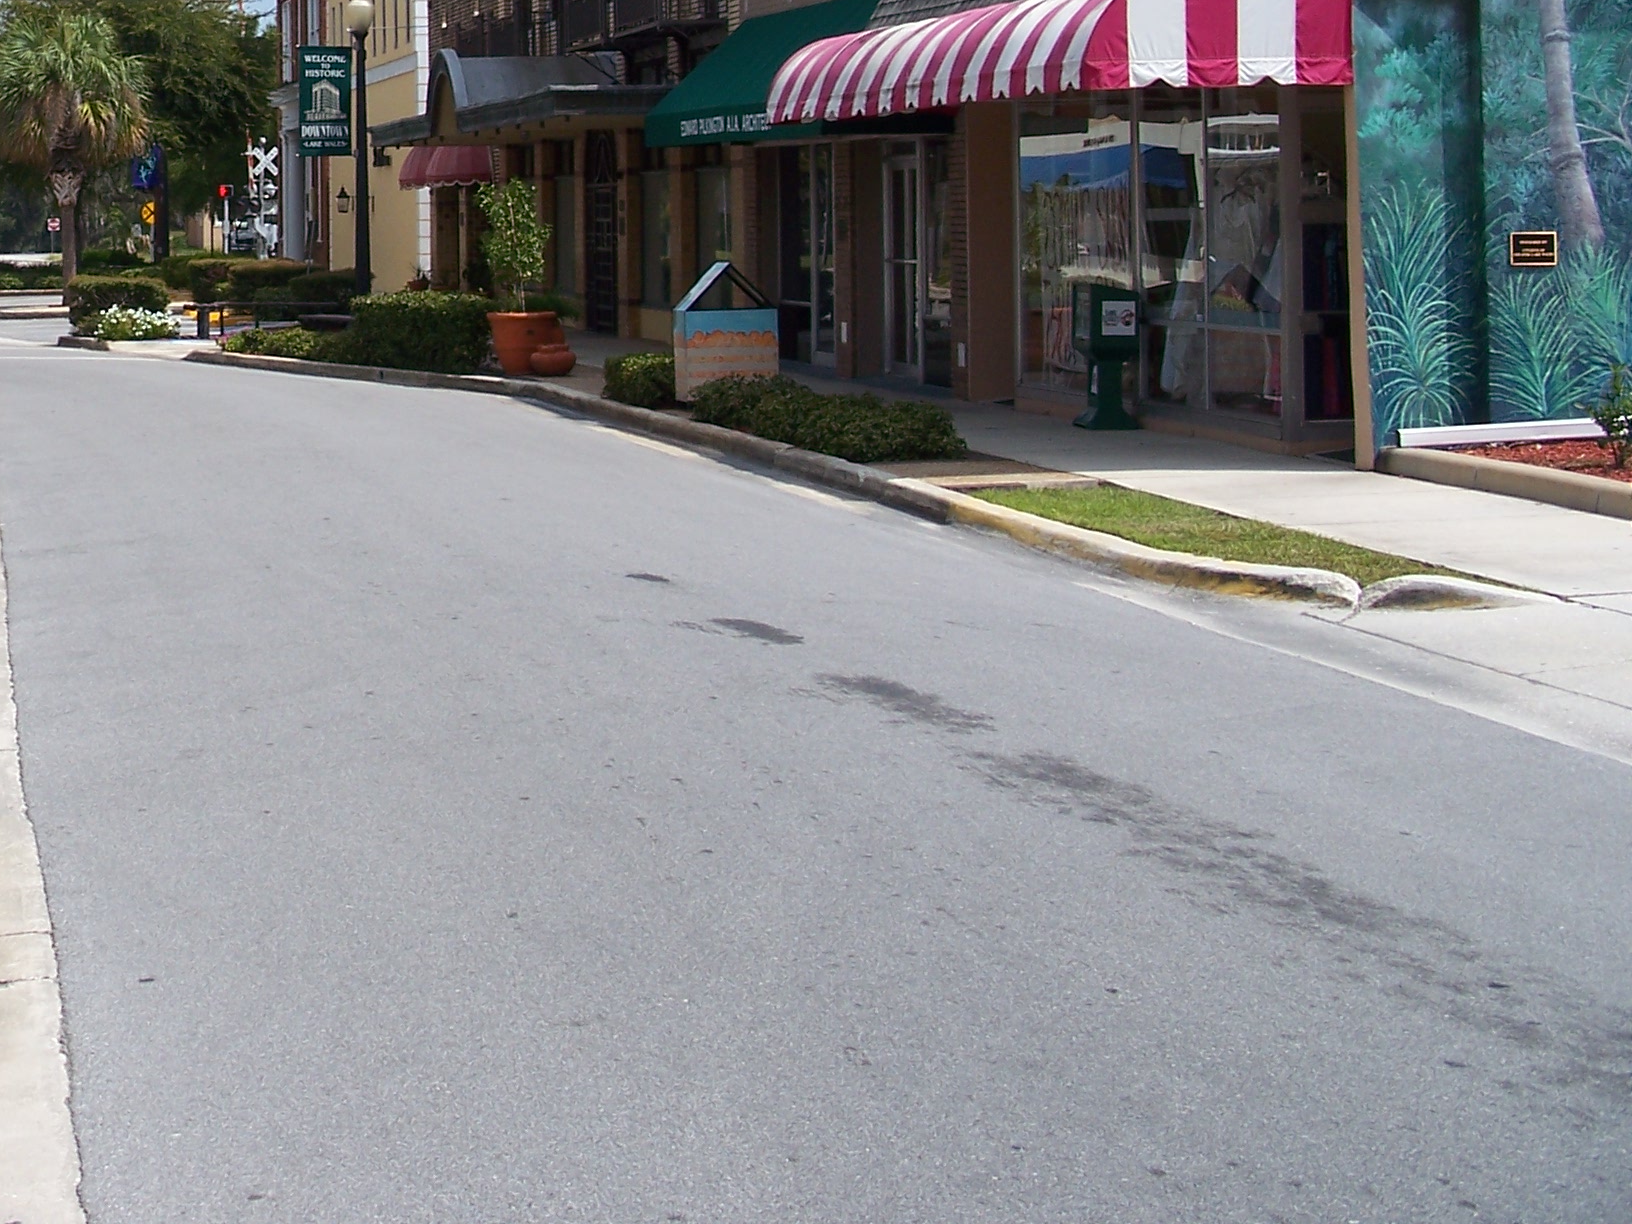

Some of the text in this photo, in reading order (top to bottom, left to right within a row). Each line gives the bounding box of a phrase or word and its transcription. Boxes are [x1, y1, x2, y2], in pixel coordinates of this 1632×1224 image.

[304, 55, 346, 63] WELCOME
[305, 69, 346, 78] HISTORIC
[301, 125, 349, 137] DOWNTOWN
